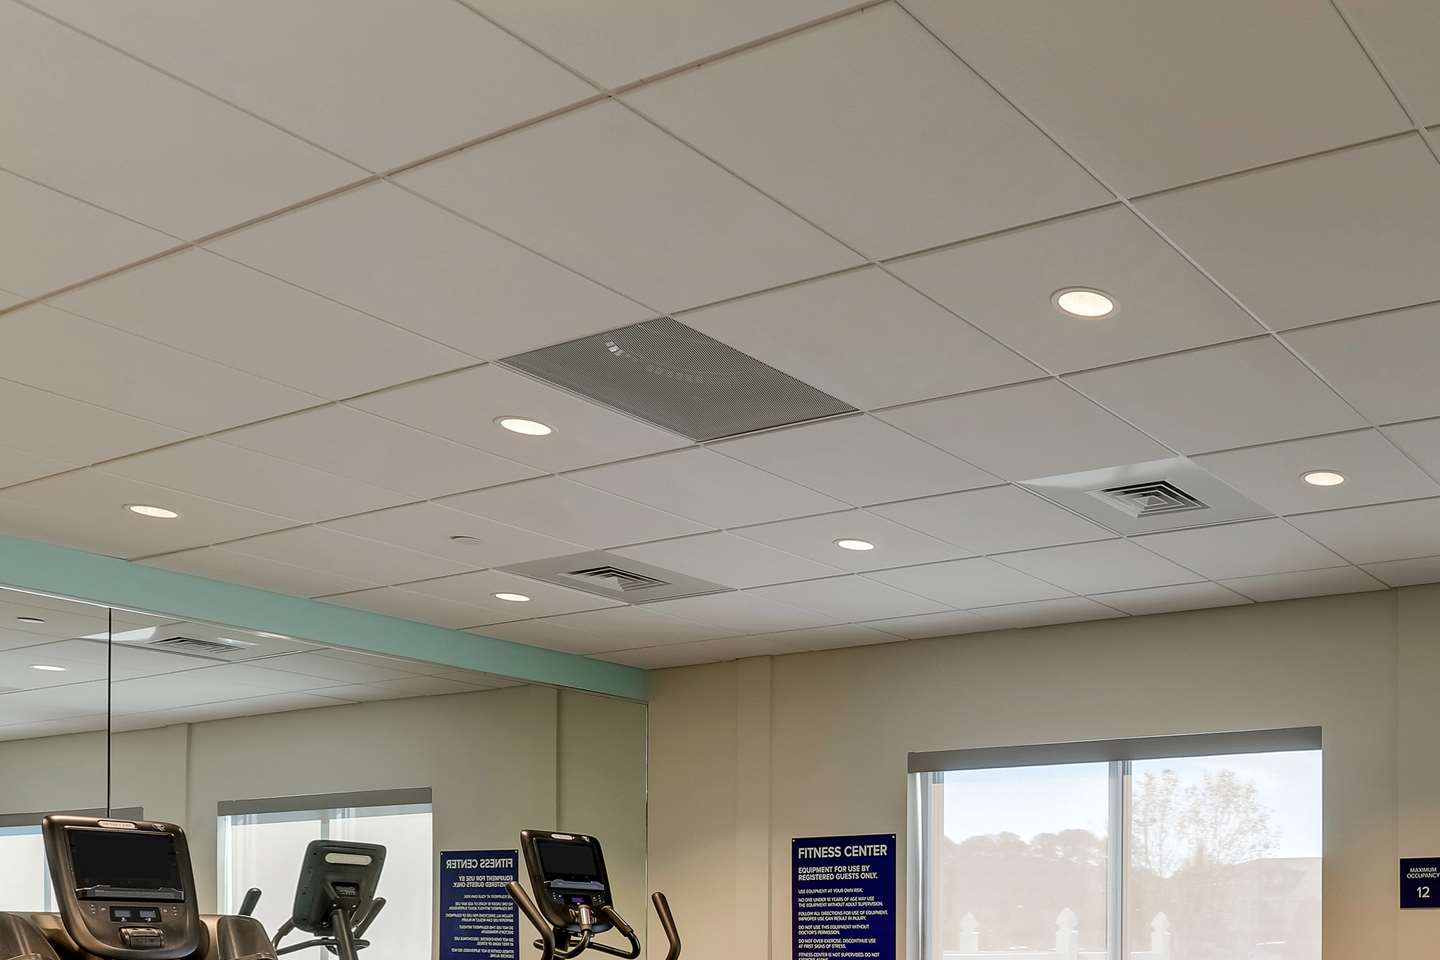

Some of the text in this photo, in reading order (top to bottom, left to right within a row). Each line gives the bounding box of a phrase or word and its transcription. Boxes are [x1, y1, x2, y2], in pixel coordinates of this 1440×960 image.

[798, 844, 887, 859] FITNESS CENTER
[798, 866, 832, 874] EQUIPMENT
[798, 872, 834, 881] REGISTERED
[835, 872, 859, 880] GUESTS
[1417, 887, 1430, 898] 12
